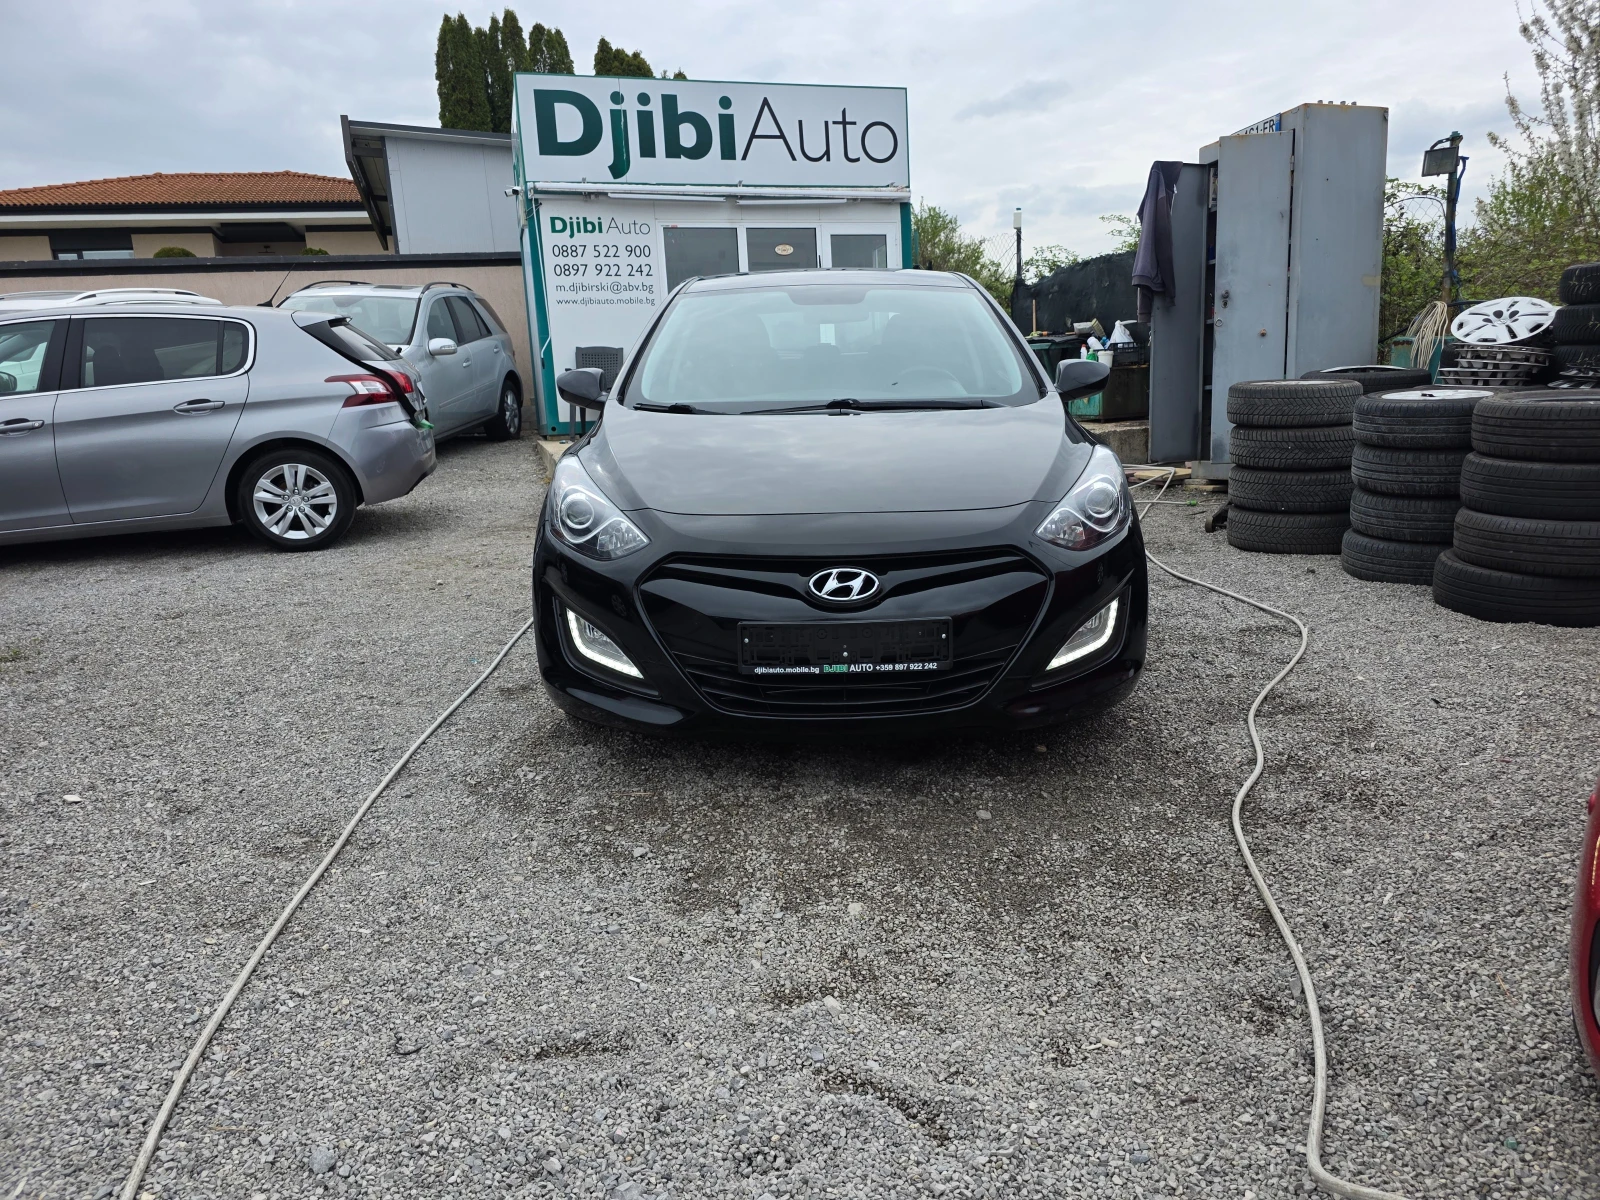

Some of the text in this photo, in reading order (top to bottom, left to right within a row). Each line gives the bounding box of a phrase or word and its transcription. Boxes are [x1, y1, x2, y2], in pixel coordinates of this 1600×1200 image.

[549, 216, 651, 239] Djibi Auto
[552, 244, 651, 258] 0887 522 900
[553, 263, 653, 277] 0897 922 242
[555, 281, 654, 295] m.djibirski@abv.bg
[556, 297, 656, 307] www.djibiauto.mobile.bg
[754, 666, 820, 675] djibiauto.mobile.bg
[849, 663, 874, 672] AUTO
[894, 663, 908, 671] 897
